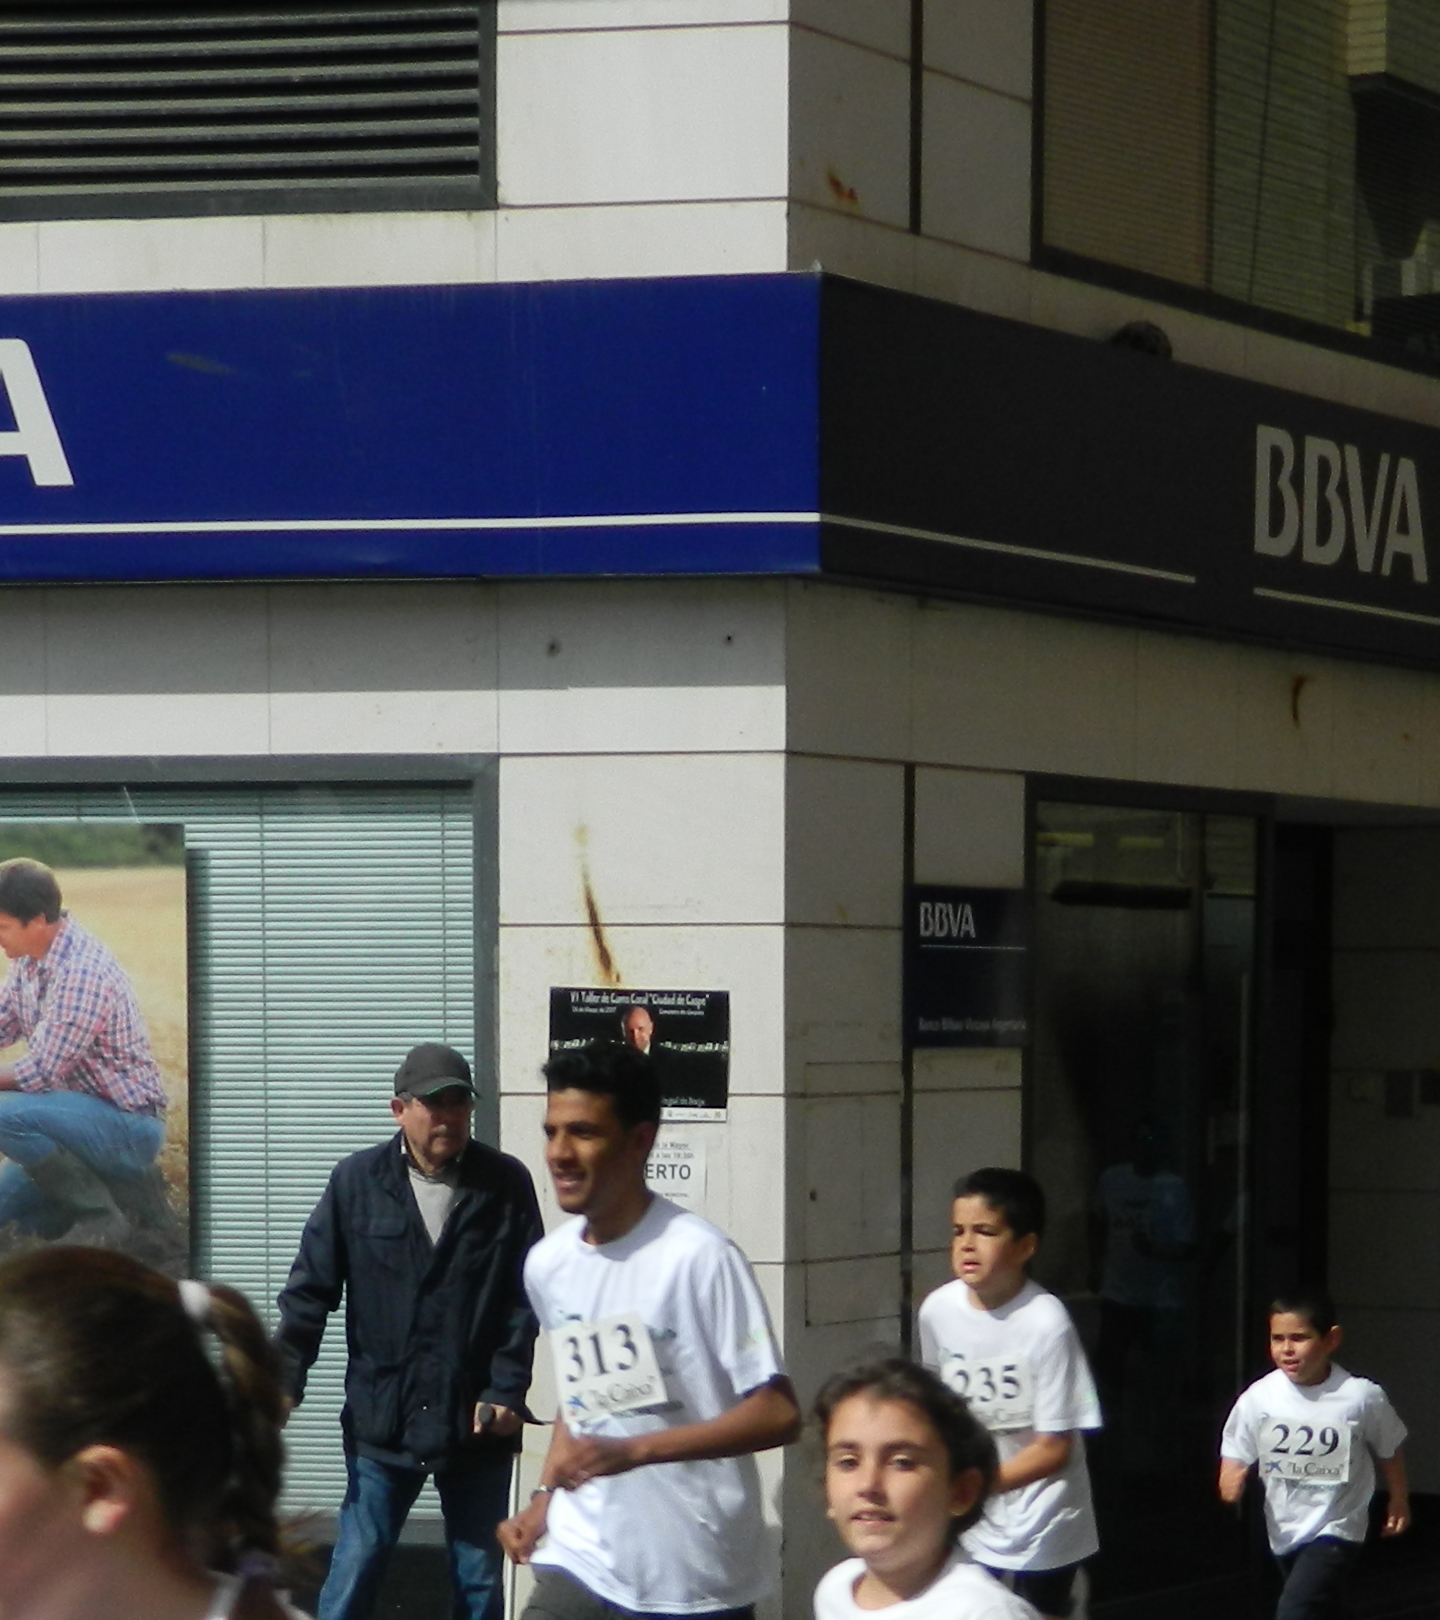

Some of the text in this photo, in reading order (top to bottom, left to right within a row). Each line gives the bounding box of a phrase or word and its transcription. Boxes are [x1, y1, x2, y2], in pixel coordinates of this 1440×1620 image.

[1254, 423, 1429, 584] BBVA
[919, 901, 976, 938] BBVA
[645, 1163, 691, 1180] ERTO
[566, 1323, 639, 1383] 313
[954, 1364, 1021, 1403] 235
[1270, 1423, 1339, 1457] 229
